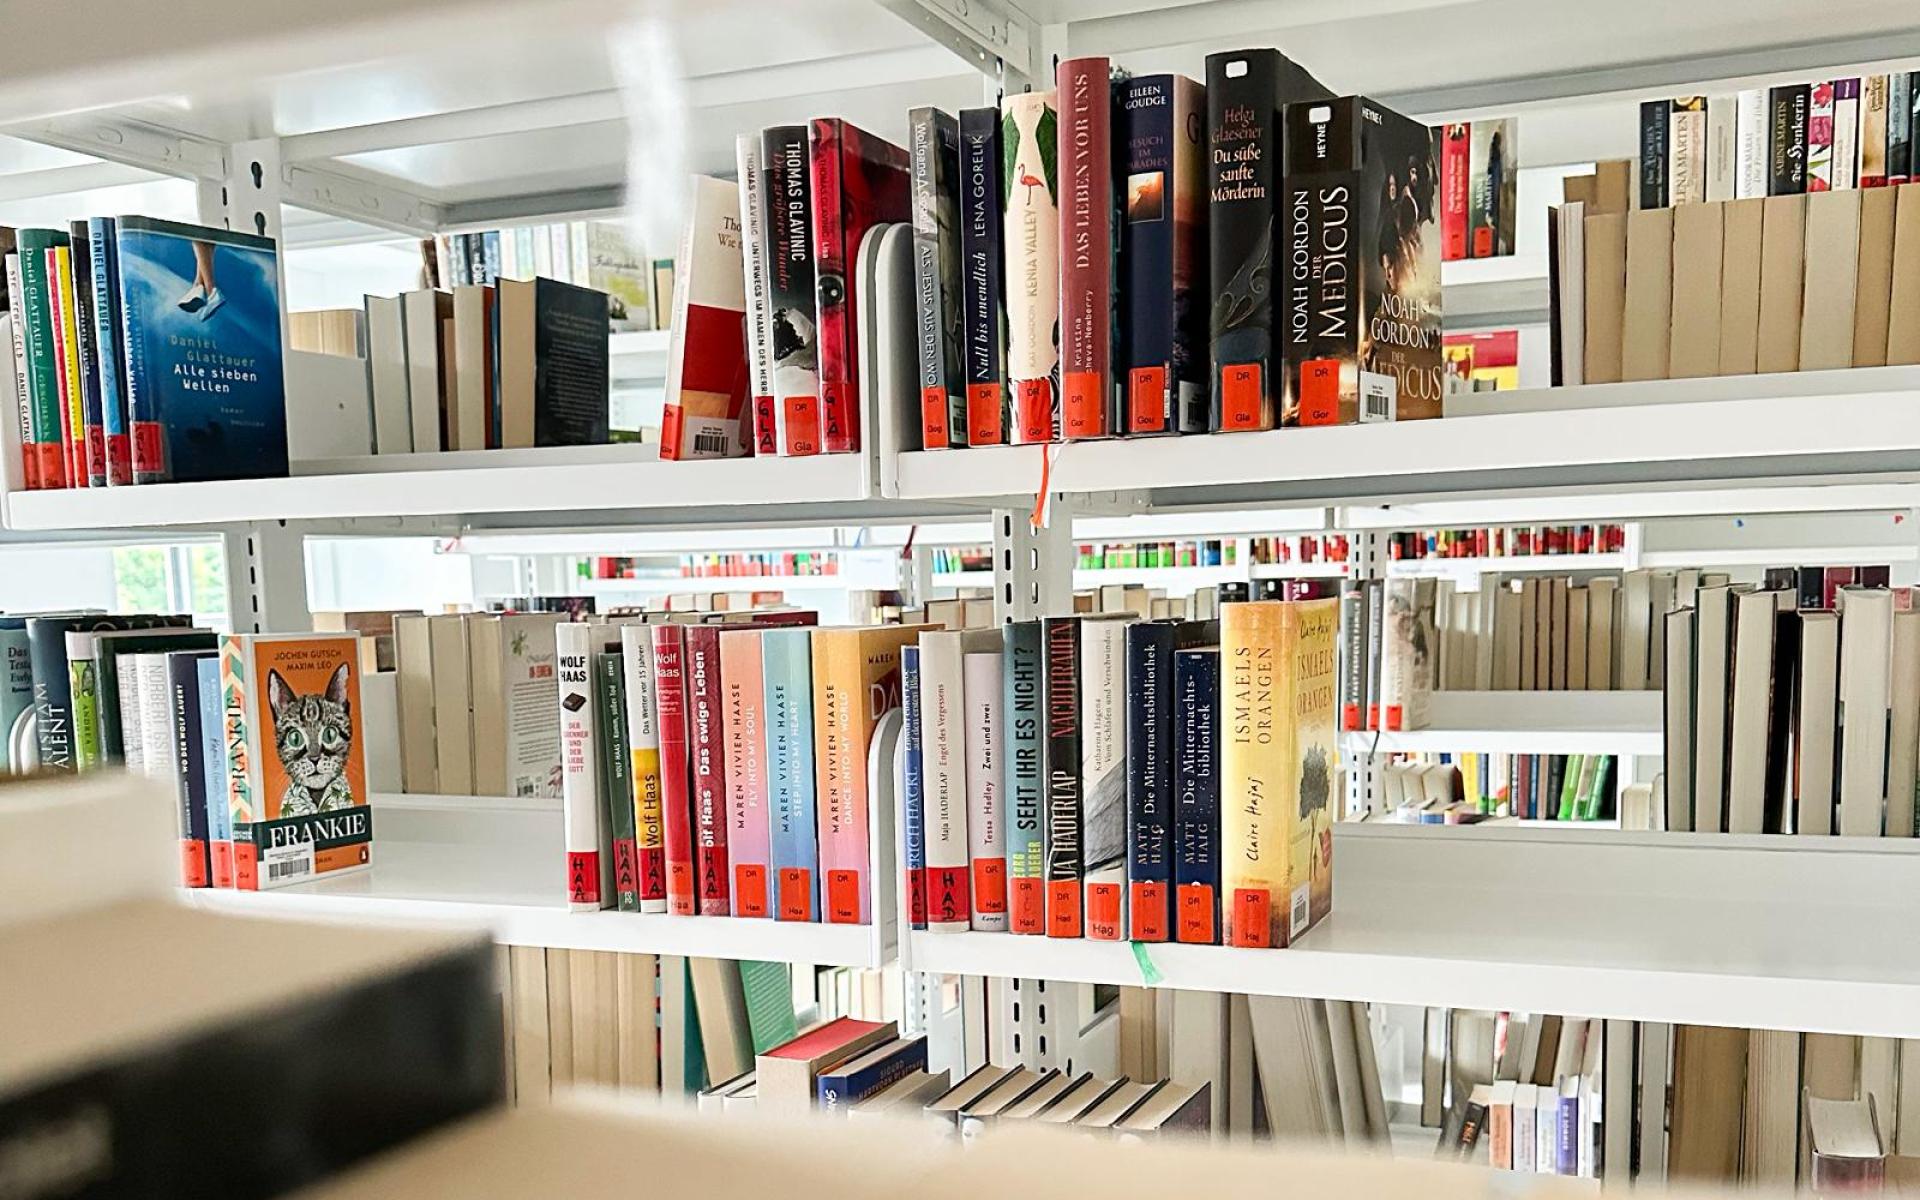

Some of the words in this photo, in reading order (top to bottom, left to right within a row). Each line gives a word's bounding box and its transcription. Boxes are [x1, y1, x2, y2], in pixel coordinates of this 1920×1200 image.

[1075, 74, 1088, 113] UNS
[1125, 96, 1167, 110] GOUDGE
[1129, 85, 1161, 98] EILEEN
[1224, 104, 1255, 127] Helga
[1787, 94, 1805, 160] Henkerin
[915, 123, 927, 178] Wolfgang
[1075, 119, 1089, 160] VOR
[1213, 149, 1230, 164] Du
[1233, 143, 1261, 161] süße
[1316, 123, 1326, 158] HEYNE
[747, 152, 757, 189] THOMAS
[785, 142, 802, 197] THOMAS
[972, 134, 985, 198] GORELIK
[1219, 162, 1254, 182] sanfte
[1791, 163, 1802, 183] Die
[1075, 163, 1089, 227] LEBEN
[1210, 182, 1265, 203] Mörderin
[749, 191, 758, 235] GLAVINIC
[974, 201, 986, 237] LENA
[790, 202, 806, 262] GLAVINIC
[1293, 191, 1309, 281] GORDON
[25, 248, 36, 283] Daniel
[94, 232, 104, 268] DANIEL
[921, 247, 931, 268] ALS
[1076, 232, 1089, 269] DAS
[1313, 254, 1321, 279] DER
[1319, 186, 1349, 339] MEDICUS
[751, 241, 763, 297] UNTERWEGS
[973, 253, 987, 318] unendlich
[96, 273, 110, 332] GLATTAUER
[922, 271, 932, 305] JESUS
[29, 287, 43, 357] GLATTAUER
[924, 308, 935, 334] AUS
[1293, 285, 1308, 343] NOAH
[1380, 292, 1419, 322] NOAH
[170, 335, 217, 349] Daniel
[755, 313, 765, 346] NAMEN
[974, 321, 988, 347] bis
[1074, 317, 1082, 367] Kristina
[1371, 317, 1429, 349] GORDON
[187, 350, 255, 367] Glattauer
[759, 348, 767, 367] DES
[926, 336, 936, 362] DEN
[975, 348, 989, 379] Null
[18, 372, 28, 402] DANIEL
[174, 364, 206, 377] Alle
[211, 368, 257, 382] sieben
[183, 379, 230, 393] Wellen
[794, 441, 812, 451] Gla
[275, 650, 309, 660] JOCHEN
[311, 648, 341, 659] GUTSCH
[287, 662, 315, 671] MAXIM
[317, 661, 332, 669] LEO
[560, 656, 586, 668] WOLF
[637, 644, 646, 669] Jahren
[869, 654, 894, 665] MAREN
[1103, 629, 1112, 687] Verschwinden
[1296, 649, 1333, 682] ISMAELS
[638, 670, 647, 679] 15
[639, 681, 648, 693] vor
[694, 651, 707, 697] Leben
[1050, 623, 1075, 739] NACHTFRAUEN
[176, 684, 185, 715] LAUERT
[640, 694, 649, 719] Wetter
[731, 683, 741, 726] HAASE
[775, 685, 786, 728] HAASE
[826, 684, 837, 728] HAASE
[839, 691, 850, 733] WORLD
[937, 683, 948, 726] Vergessens
[1103, 689, 1112, 706] und
[1235, 647, 1250, 744] ISMAELS
[1257, 647, 1272, 744] ORANGEN
[1296, 685, 1333, 717] ORANGEN
[83, 704, 91, 744] ANDREA
[178, 717, 187, 740] WOLF
[642, 721, 650, 735] Das
[697, 701, 710, 744] ewige
[746, 705, 756, 736] SOUL
[789, 700, 800, 737] HEART
[981, 703, 990, 725] zwei
[1093, 697, 1102, 729] Hagena
[1103, 708, 1112, 742] Schlafen
[1143, 644, 1156, 788] Mitternachtsbibliothek
[1182, 675, 1196, 774] Mitternachts-
[227, 697, 246, 794] FRANKIE
[841, 736, 851, 755] MY
[937, 728, 946, 743] des
[982, 728, 991, 745] und
[1015, 719, 1036, 741] ES
[1197, 704, 1211, 777] bibliothek
[180, 740, 188, 758] DER
[613, 743, 622, 760] HAAS
[700, 748, 710, 776] Das
[733, 732, 743, 777] VIVIEN
[746, 740, 756, 757] MY
[777, 735, 788, 780] VIVIEN
[790, 738, 801, 758] MY
[828, 735, 838, 781] VIVIEN
[938, 744, 948, 766] Engel
[982, 748, 992, 770] Zwei
[1015, 748, 1037, 779] IHR
[1093, 731, 1102, 772] Katharina
[1103, 744, 1111, 763] Vom
[182, 758, 189, 773] WO
[614, 761, 623, 778] WOLF
[747, 759, 757, 786] INTO
[791, 760, 802, 788] INTO
[841, 756, 852, 784] INTO
[643, 774, 656, 810] Haas
[701, 790, 713, 825] Haas
[734, 785, 745, 829] MAREN
[747, 787, 758, 808] FLY
[792, 790, 803, 817] STEP
[843, 788, 855, 825] DANCE
[906, 768, 919, 820] HACKL
[939, 771, 950, 820] HADERLAP
[983, 781, 994, 815] Hadley
[1016, 785, 1037, 830] SEHT
[1143, 792, 1155, 814] Die
[1182, 779, 1195, 804] Die
[1244, 777, 1264, 816] Hajaj
[779, 788, 790, 833] MAREN
[829, 788, 841, 833] MAREN
[1051, 771, 1077, 852] HADERLAP
[270, 813, 366, 849] FRANKIE
[643, 814, 659, 847] Wolf
[941, 823, 950, 841] Maja
[984, 820, 993, 844] Tessa
[1137, 823, 1148, 864] MATT
[1150, 823, 1161, 864] HAIG
[1184, 822, 1195, 864] MATT
[1198, 823, 1208, 863] HAIG
[1246, 823, 1259, 861] Claire
[1093, 923, 1114, 936] Hag
